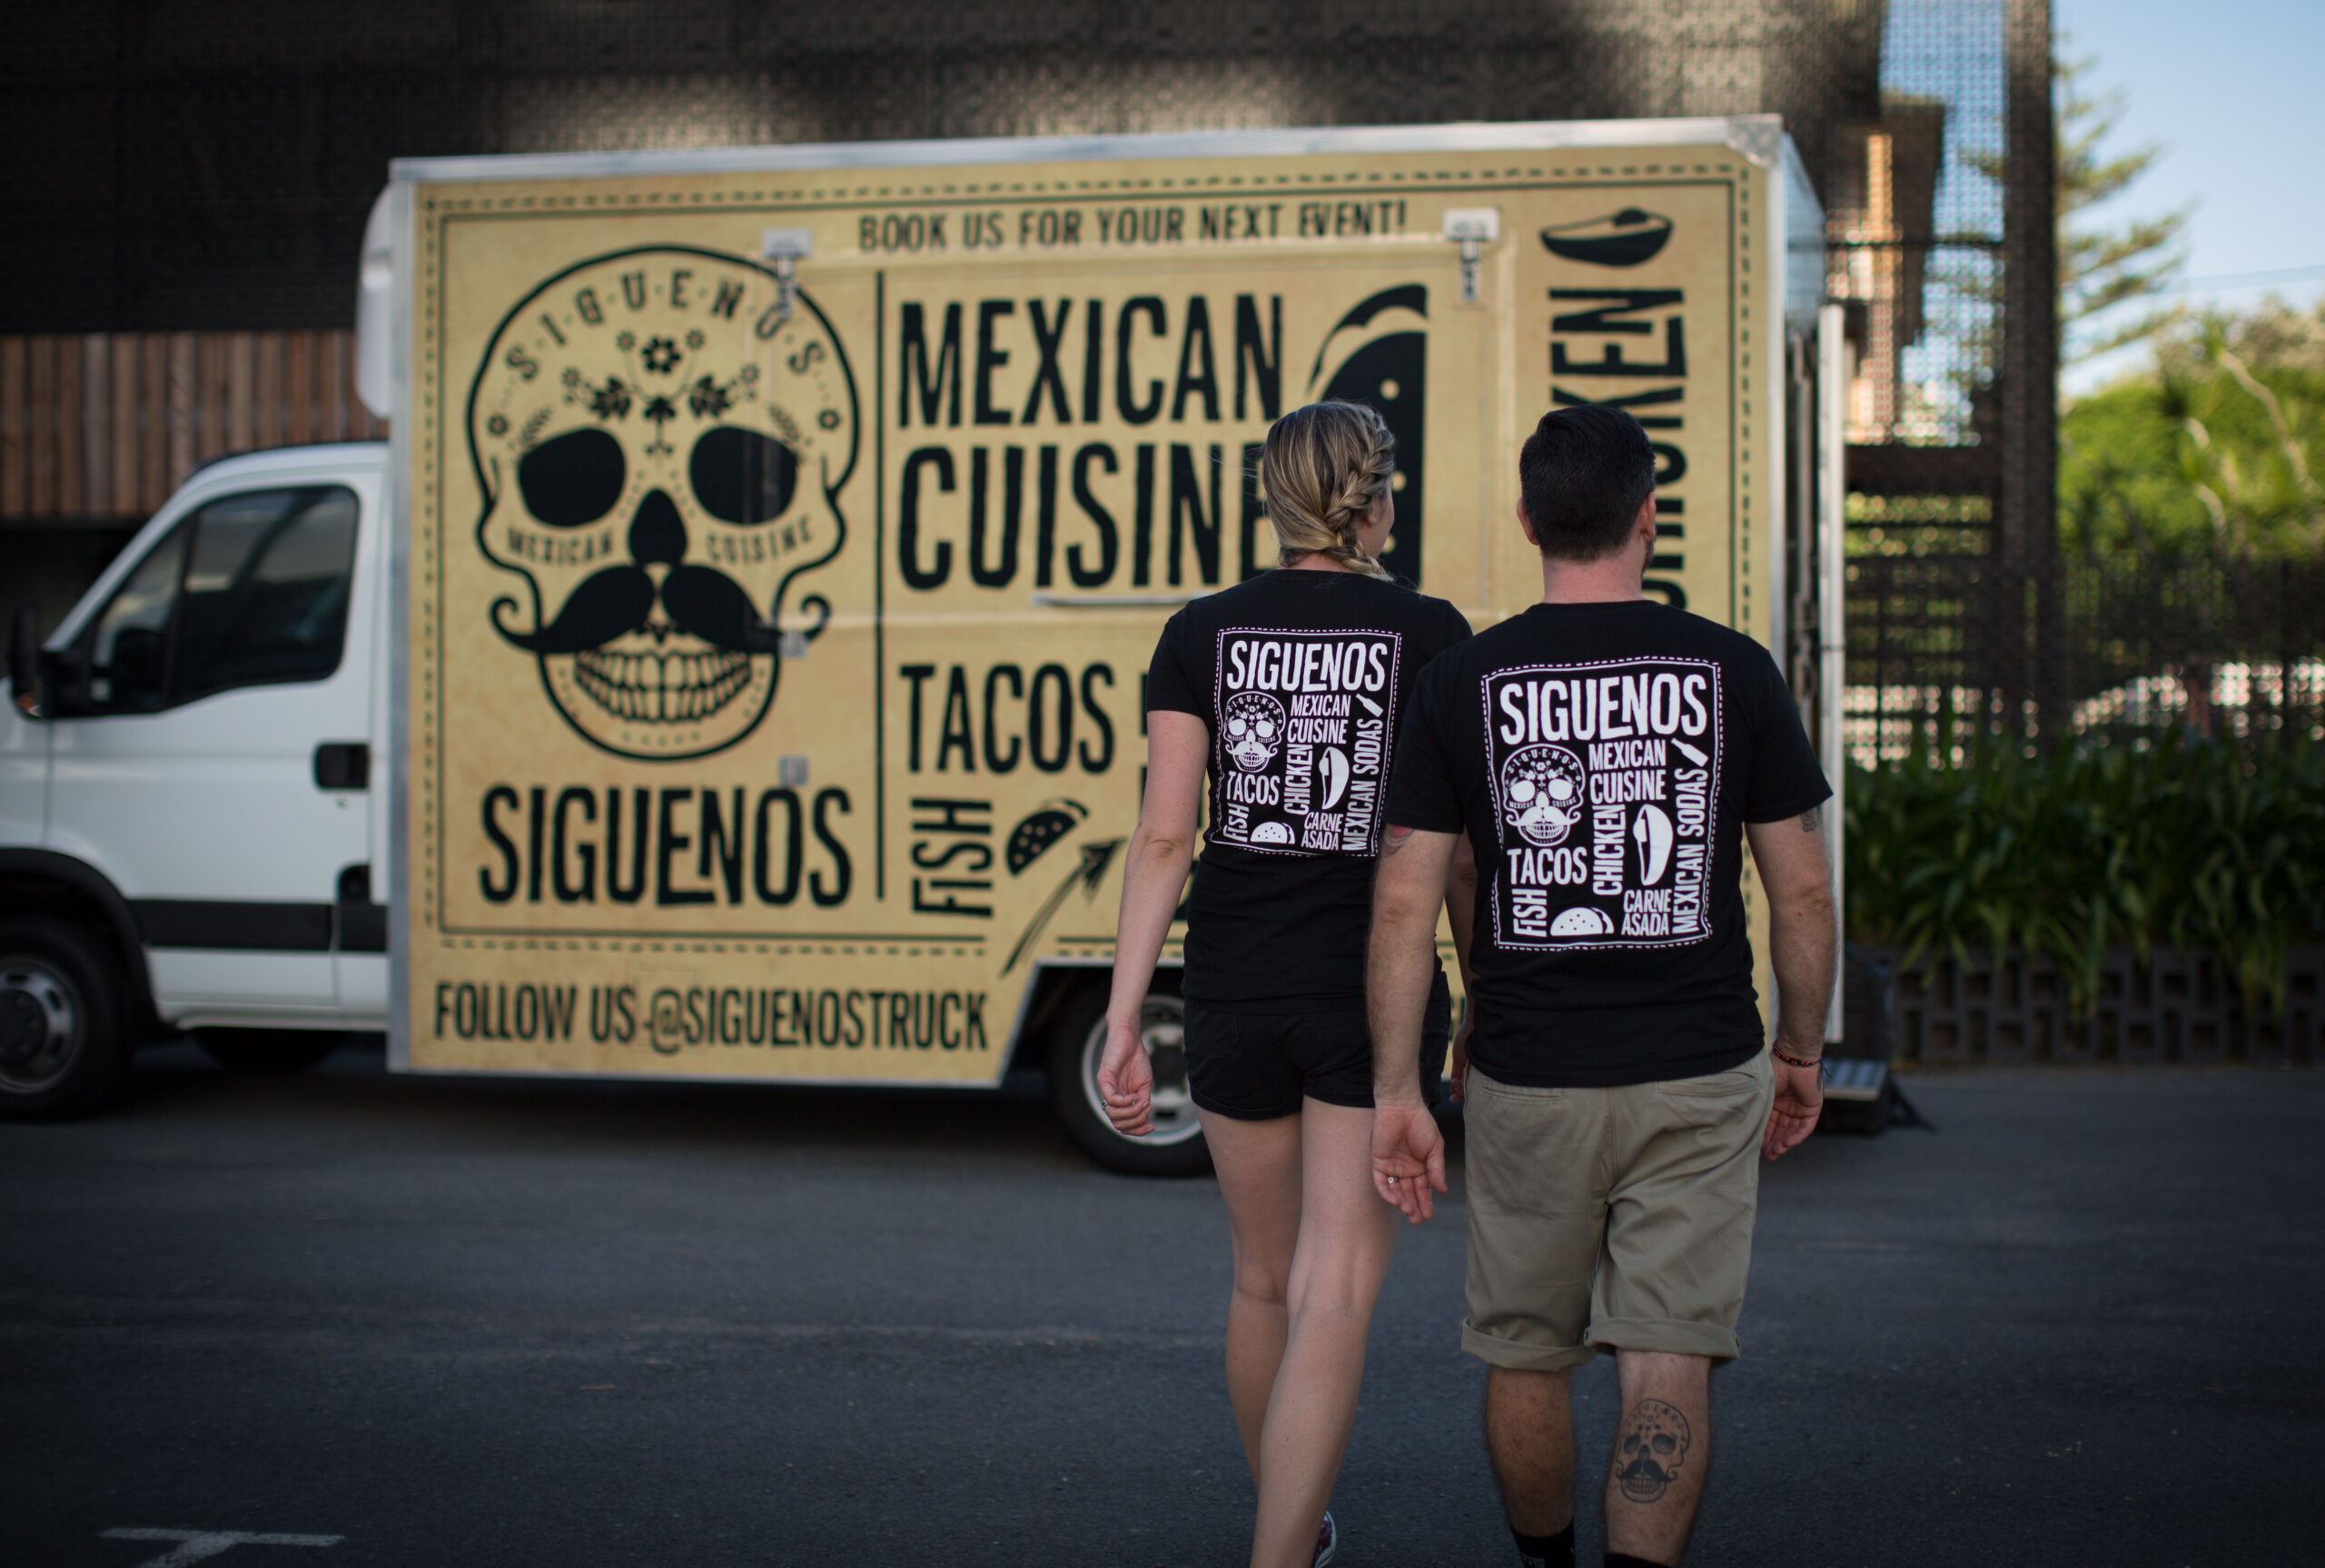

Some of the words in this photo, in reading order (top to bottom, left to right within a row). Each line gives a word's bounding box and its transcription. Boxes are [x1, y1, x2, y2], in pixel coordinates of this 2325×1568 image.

[859, 214, 947, 251] BOOK
[964, 212, 1005, 249] US
[1020, 210, 1082, 246] FOR
[1097, 206, 1185, 244] YOUR
[1199, 204, 1283, 240] NEXT
[1299, 199, 1407, 237] EVENT!
[899, 294, 1282, 428] MEXICAN
[508, 525, 614, 565] MEXICAN
[707, 514, 815, 564] CUISINE
[1226, 640, 1389, 692] SIGUENOS
[899, 663, 1115, 774] TACOS
[1290, 694, 1351, 716] MEXICAN
[1499, 673, 1708, 745] SIGUENOS
[1287, 718, 1349, 745] CUISINE
[1352, 718, 1384, 775] SODAS
[1588, 739, 1667, 771] MEXICAN
[1226, 771, 1281, 806] TACOS
[1283, 744, 1313, 815] CHICKEN
[1552, 796, 1577, 807] CUISINE
[1589, 769, 1667, 804] CUISINE
[1675, 768, 1709, 837] SODAS
[1222, 803, 1250, 843] FISH
[1304, 812, 1344, 833] CARNE
[1341, 780, 1378, 851] MEXICAN
[1509, 801, 1534, 809] MEXICAN
[480, 784, 853, 908] SIGUENOS
[910, 796, 994, 918] FISH
[1301, 831, 1340, 851] ASADA
[1507, 846, 1588, 885] TACOS
[1592, 804, 1627, 896] CHICKEN
[1511, 888, 1548, 937] FISH
[1623, 888, 1673, 913] CARNE
[1672, 843, 1706, 934] MEXICAN
[1621, 912, 1669, 936] ASADA
[435, 981, 577, 1040] FOLLOW
[591, 983, 636, 1042] US
